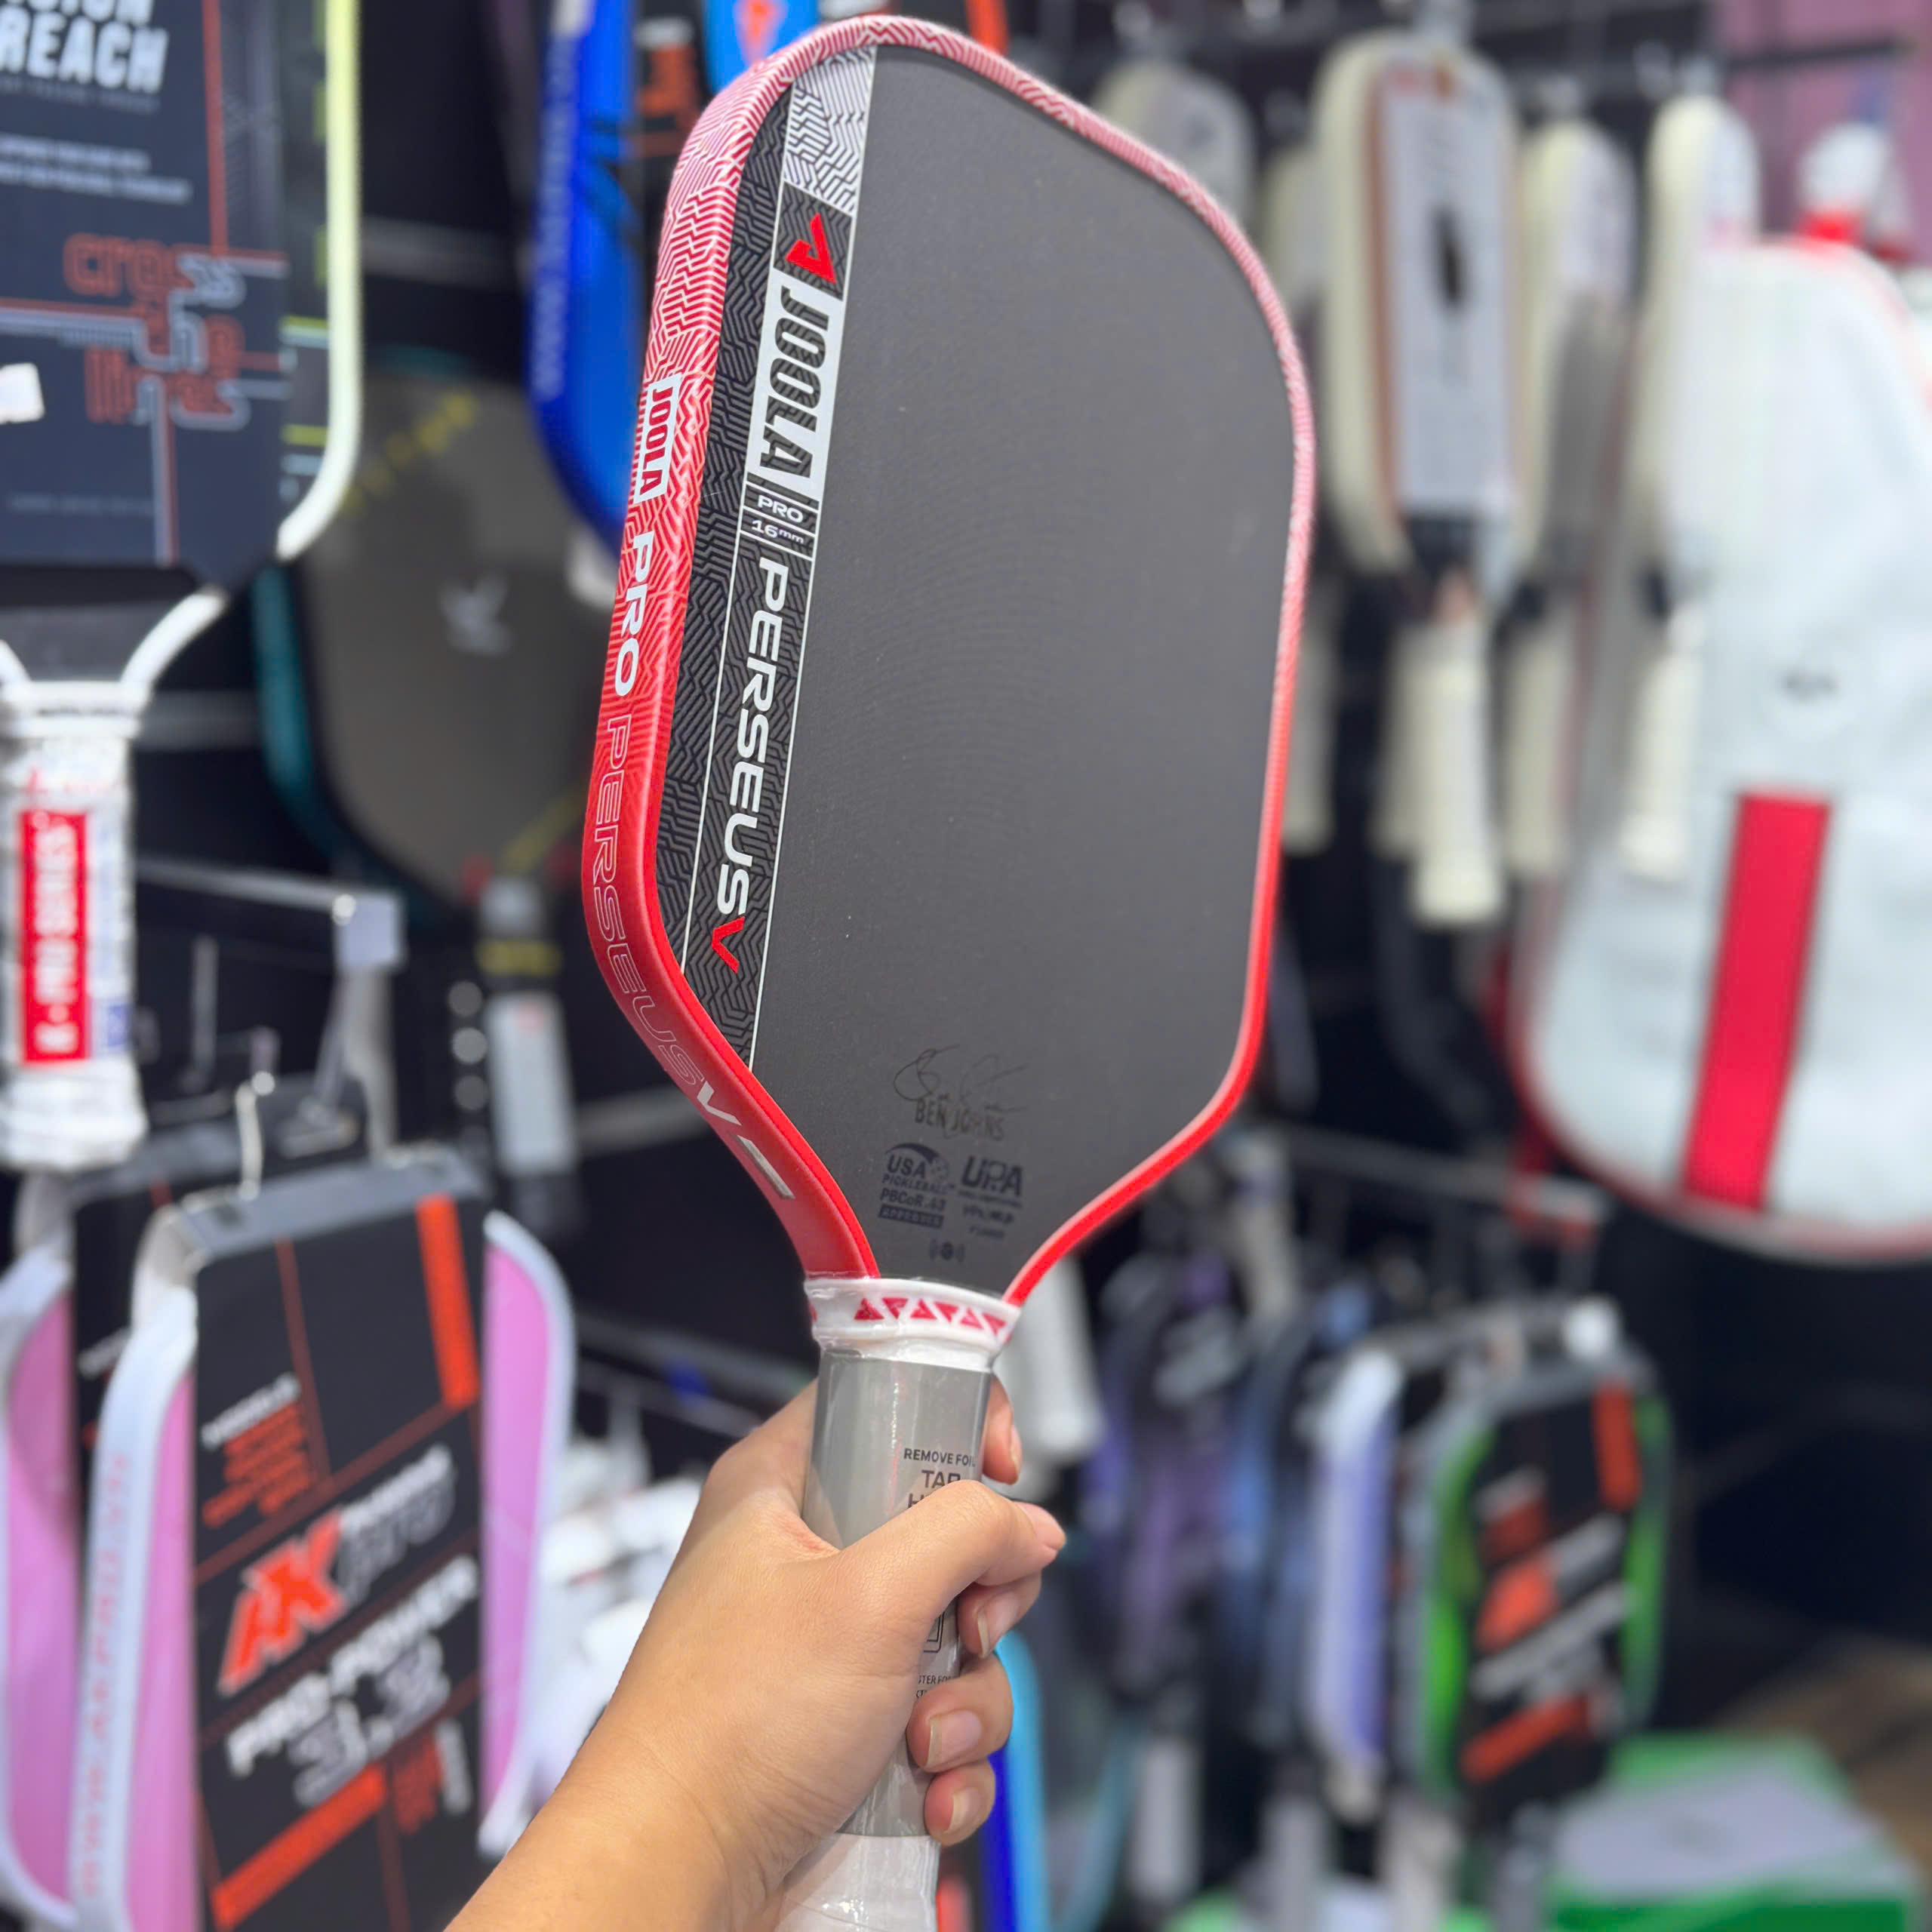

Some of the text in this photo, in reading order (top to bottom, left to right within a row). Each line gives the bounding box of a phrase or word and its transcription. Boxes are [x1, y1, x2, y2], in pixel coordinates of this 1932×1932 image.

[758, 285, 829, 478] JOOLA
[639, 386, 673, 494] JOOLA
[758, 494, 803, 523] PRO
[751, 519, 804, 544] 16mm
[615, 531, 654, 697] PRO
[717, 556, 788, 915] PERSEUS
[592, 713, 704, 1087] PERSEUS
[915, 1097, 946, 1129] BEN
[888, 1154, 927, 1179] USA
[960, 1155, 1023, 1198] UPA
[903, 1448, 954, 1465] REMOVE
